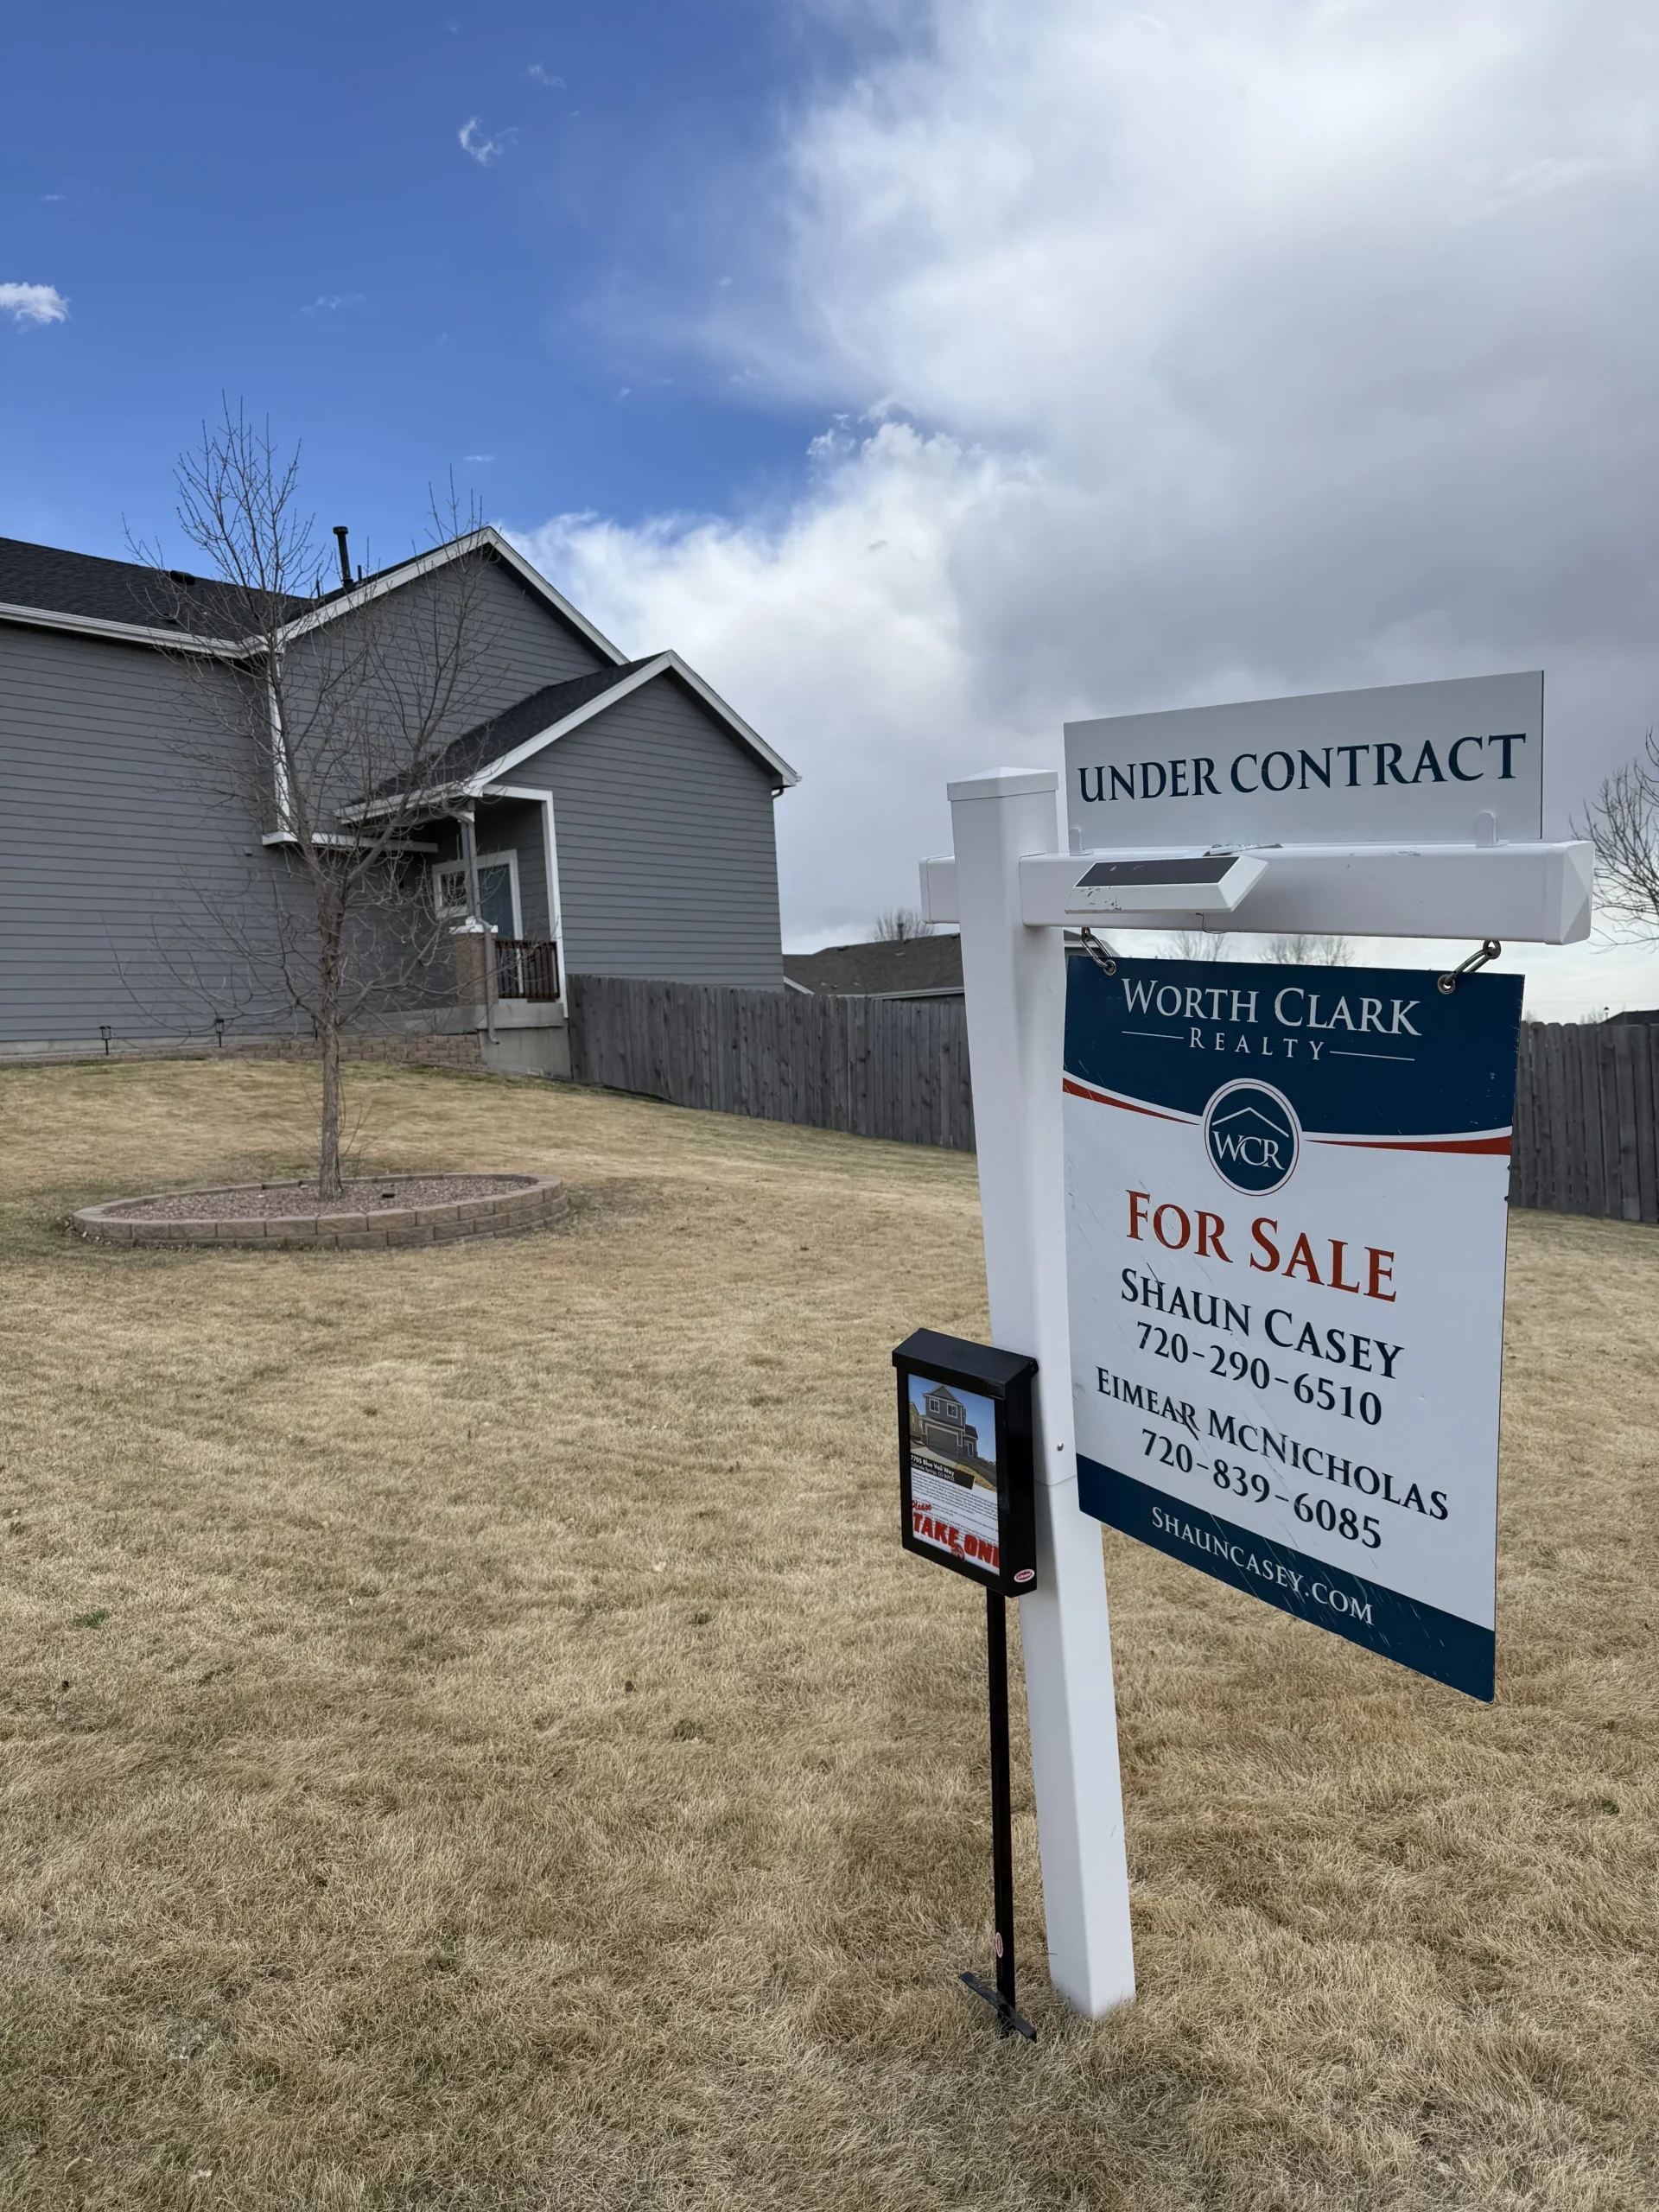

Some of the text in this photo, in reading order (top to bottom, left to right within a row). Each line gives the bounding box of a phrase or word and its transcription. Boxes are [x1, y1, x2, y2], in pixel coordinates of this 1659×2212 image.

[1077, 734, 1526, 803] UNDER CONTRACT
[1122, 978, 1421, 1036] WORTH CLARK
[1189, 1027, 1325, 1061] REALTY
[1212, 1131, 1285, 1170] WCR
[1125, 1190, 1397, 1302] FOR SALE
[1122, 1268, 1404, 1379] SHAUN CASEY
[1136, 1321, 1382, 1425] 720-290-6510
[944, 1467, 954, 1476] Way
[1096, 1366, 1449, 1521] EIMEAR MCNICHOLAS
[913, 1512, 959, 1548] TAKE
[1141, 1428, 1382, 1549] 720-839-6085
[1152, 1506, 1373, 1625] SHAUNCASEY.COM
